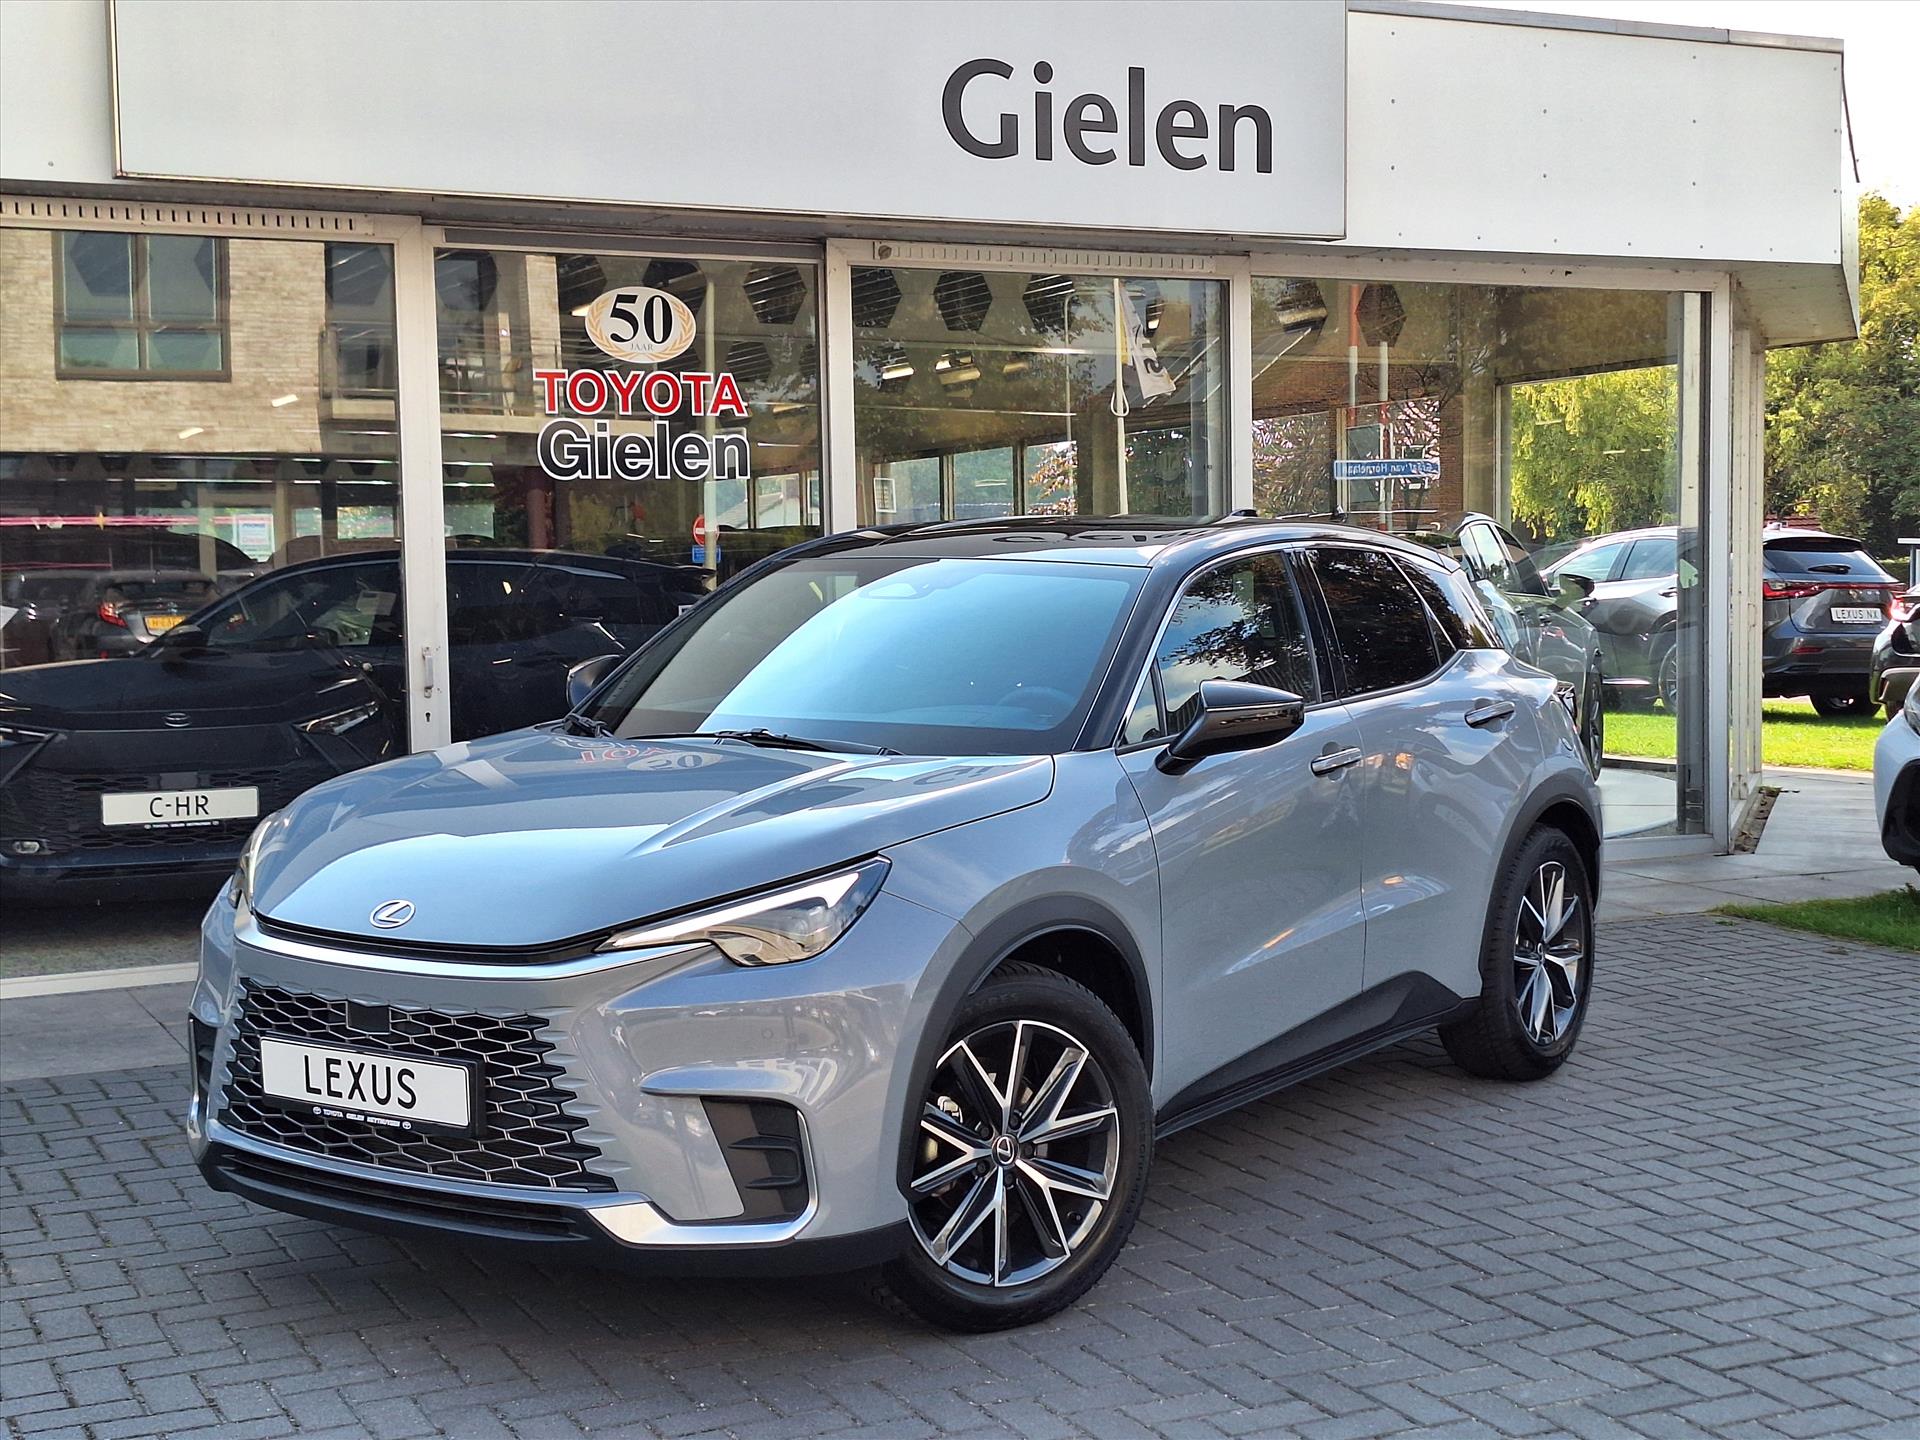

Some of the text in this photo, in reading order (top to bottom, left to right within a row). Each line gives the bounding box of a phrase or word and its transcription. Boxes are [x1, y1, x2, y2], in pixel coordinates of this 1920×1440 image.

[942, 58, 1273, 174] Gielen
[609, 293, 673, 345] 50
[629, 342, 655, 353] JAAR
[533, 369, 749, 417] TOYOTA
[536, 417, 751, 481] Gielen
[1835, 609, 1878, 619] LEXUS NX
[149, 795, 209, 818] C-HR
[303, 1054, 417, 1109] LEXUS
